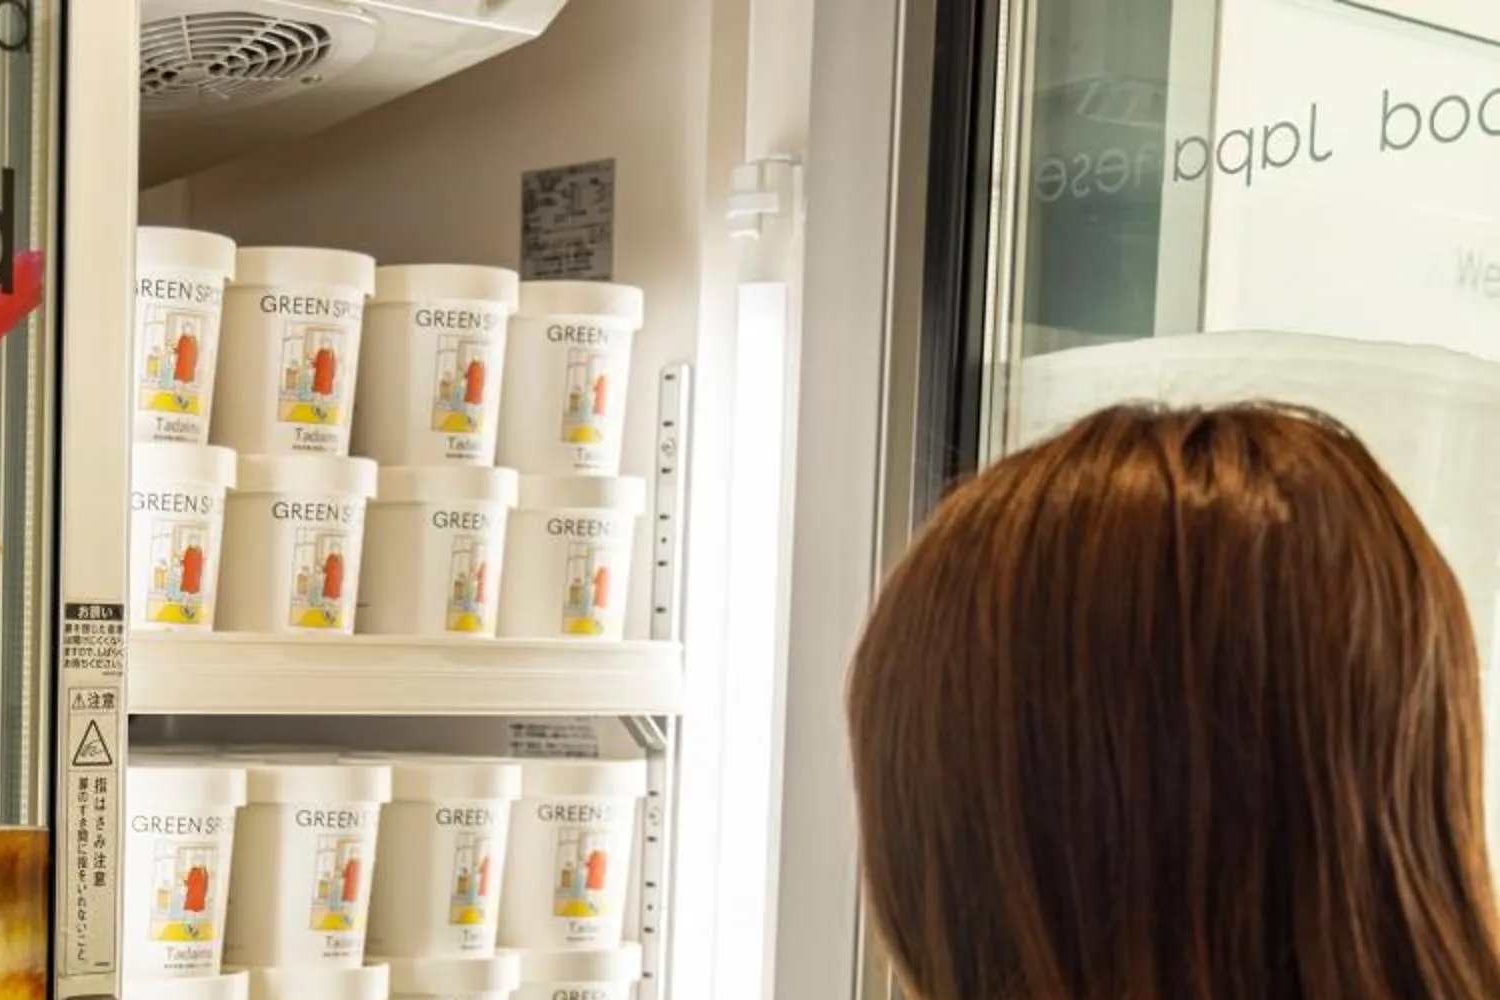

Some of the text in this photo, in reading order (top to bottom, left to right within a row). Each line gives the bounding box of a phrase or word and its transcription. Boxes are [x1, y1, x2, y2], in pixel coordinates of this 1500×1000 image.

[135, 279, 192, 300] REEN
[260, 295, 329, 315] GREEN
[416, 309, 481, 329] GREEN
[547, 325, 609, 343] GREEN
[131, 492, 197, 513] GREEN
[272, 501, 338, 520] GREEN
[547, 518, 610, 537] GREEN
[295, 809, 359, 829] GREEN
[435, 807, 494, 826] GREEN
[537, 804, 602, 823] GREEN
[131, 815, 202, 834] GREEN
